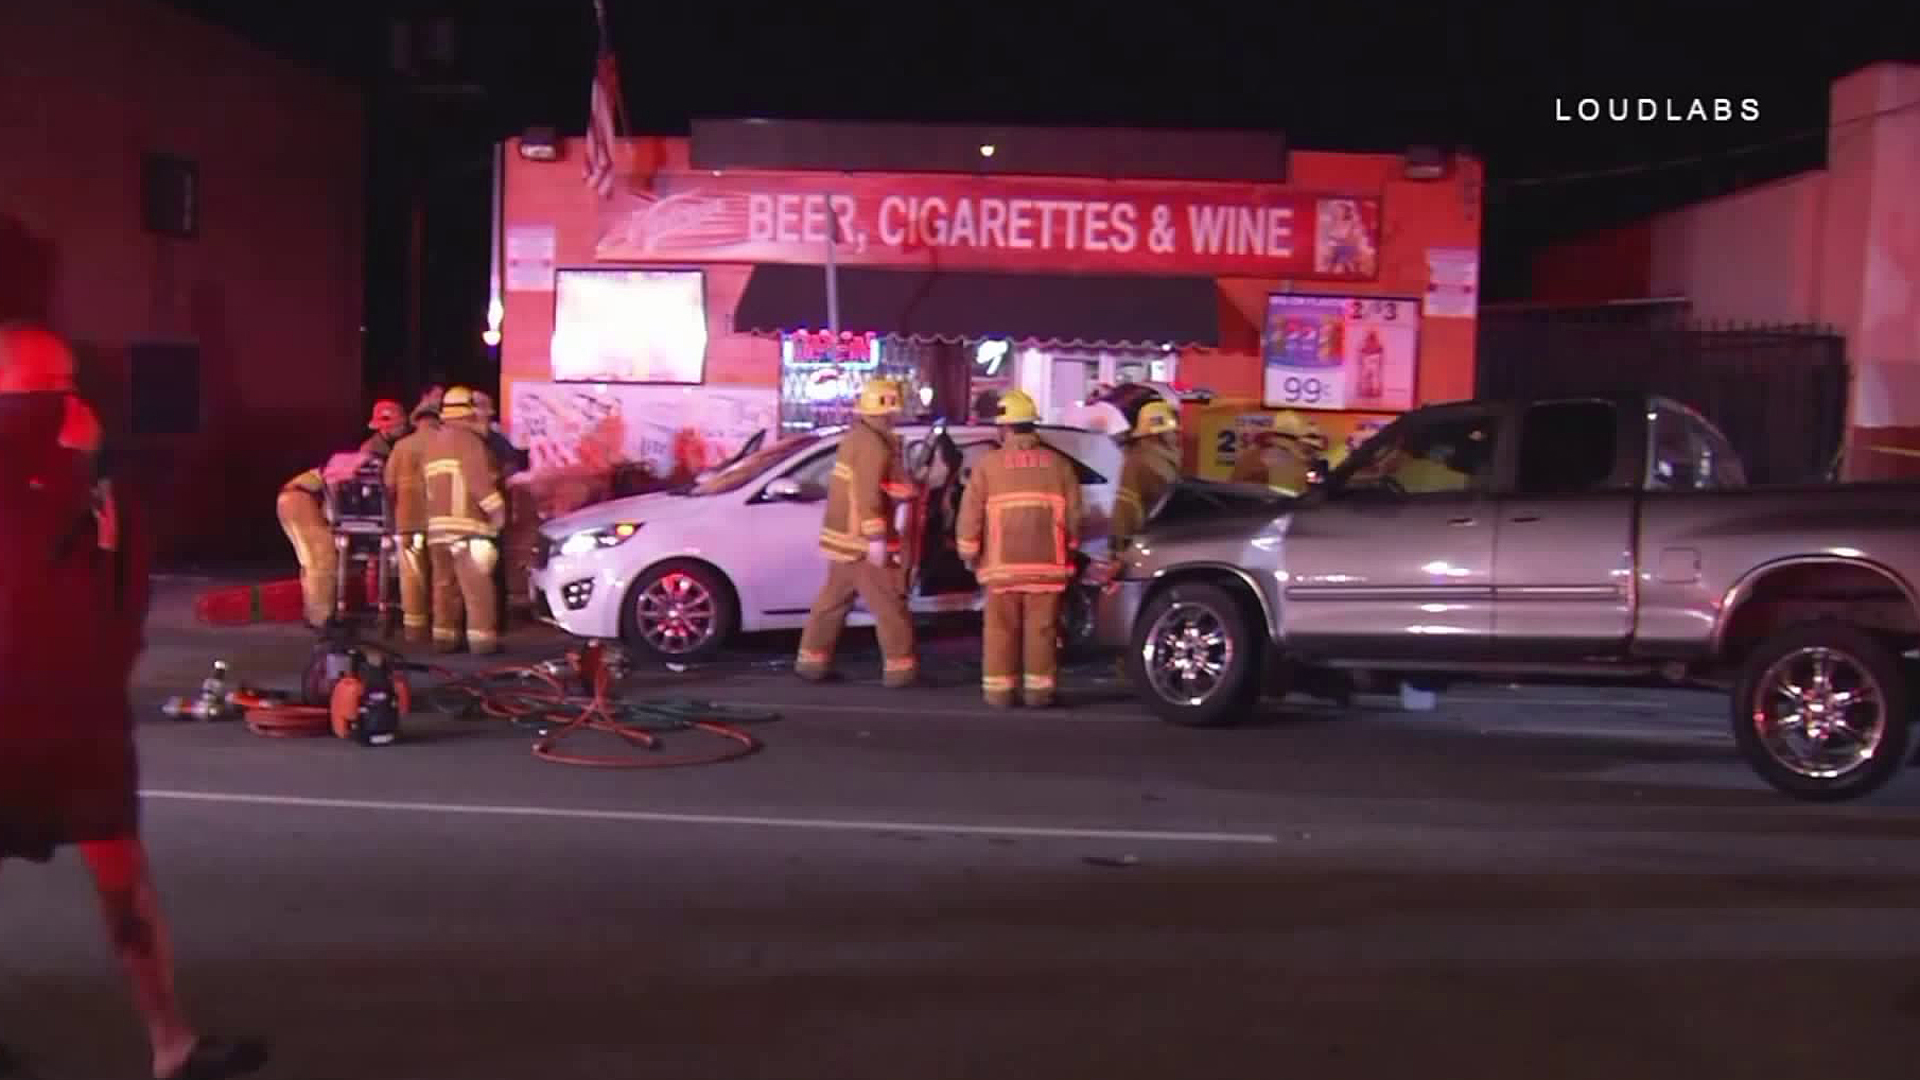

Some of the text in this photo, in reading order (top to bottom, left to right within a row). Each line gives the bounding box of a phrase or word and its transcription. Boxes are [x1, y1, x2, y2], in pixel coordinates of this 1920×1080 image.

[749, 194, 868, 253] BEER,
[877, 196, 1138, 252] CIGARETTES
[1148, 204, 1175, 253] &
[1187, 204, 1293, 257] WINE
